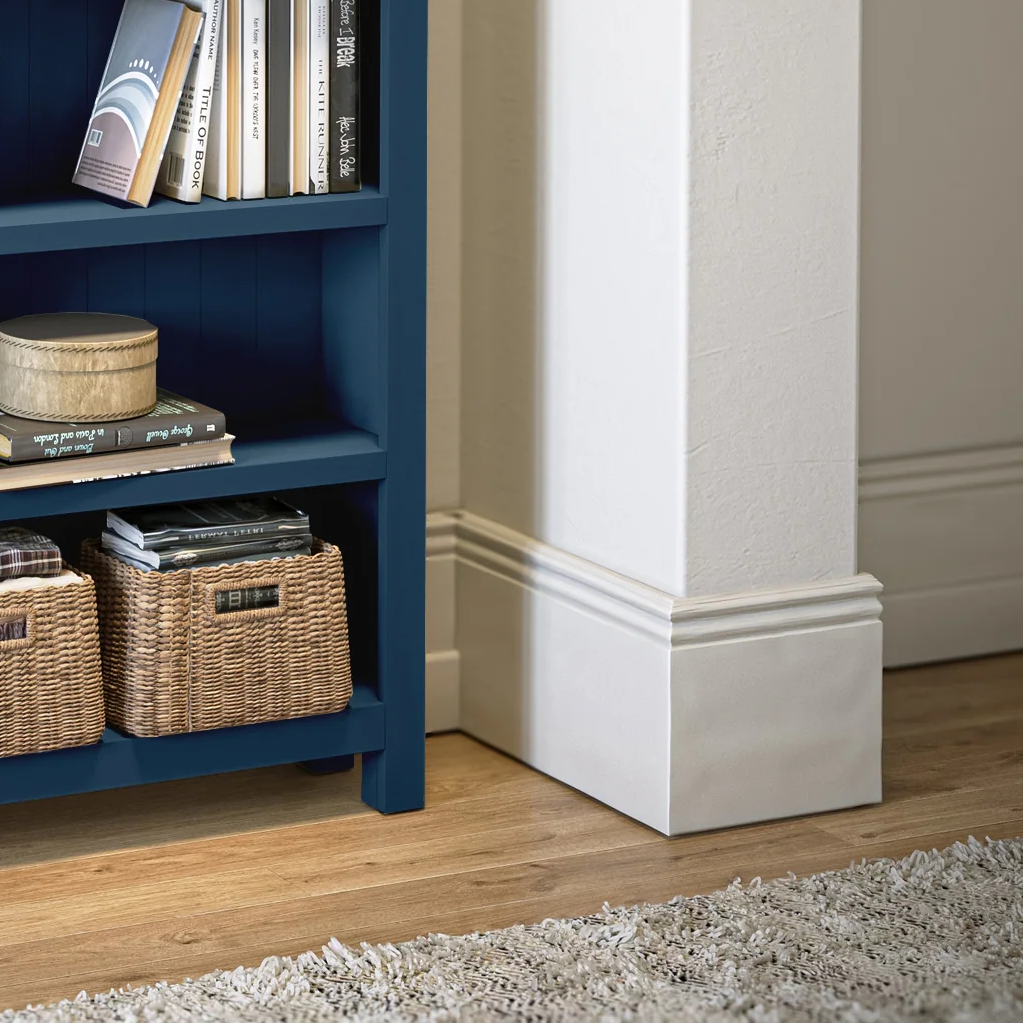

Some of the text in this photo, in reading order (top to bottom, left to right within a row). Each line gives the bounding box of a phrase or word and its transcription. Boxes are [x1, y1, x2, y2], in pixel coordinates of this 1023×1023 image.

[207, 35, 217, 60] NAME
[199, 85, 212, 122] TITLE
[339, 133, 356, 156] John
[191, 150, 204, 189] BOOK
[339, 156, 356, 178] Belle
[33, 432, 59, 446] London
[60, 430, 74, 444] and
[171, 424, 194, 438] George
